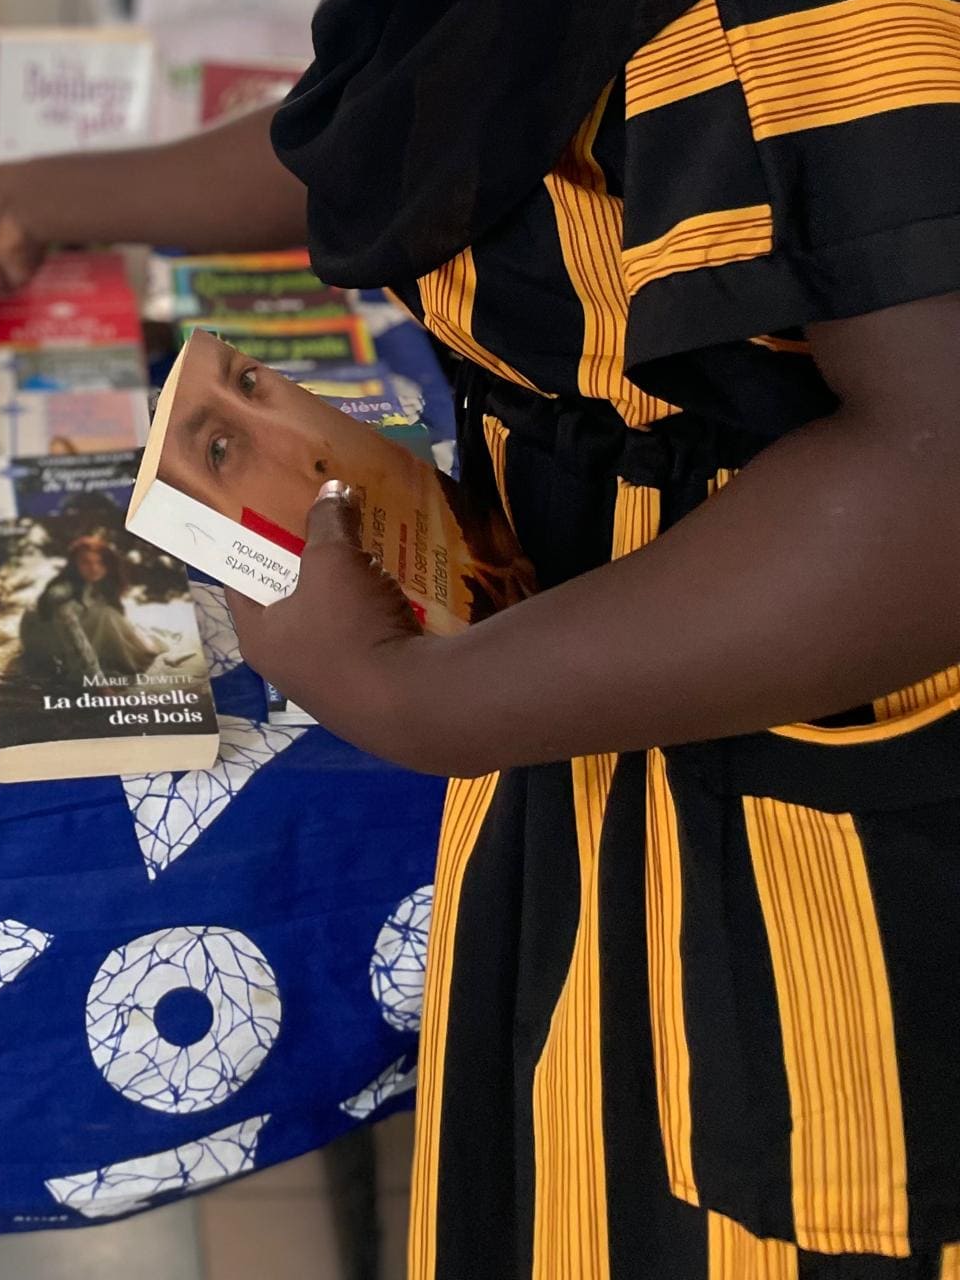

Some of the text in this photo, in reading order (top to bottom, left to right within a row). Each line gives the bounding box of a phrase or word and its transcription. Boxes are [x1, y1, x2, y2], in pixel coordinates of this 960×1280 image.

[225, 555, 255, 579] verts
[232, 540, 291, 577] inattendu
[258, 573, 290, 596] yeux
[83, 674, 129, 688] MARIE
[43, 689, 199, 710] La damoiselle
[108, 708, 204, 726] des bois
